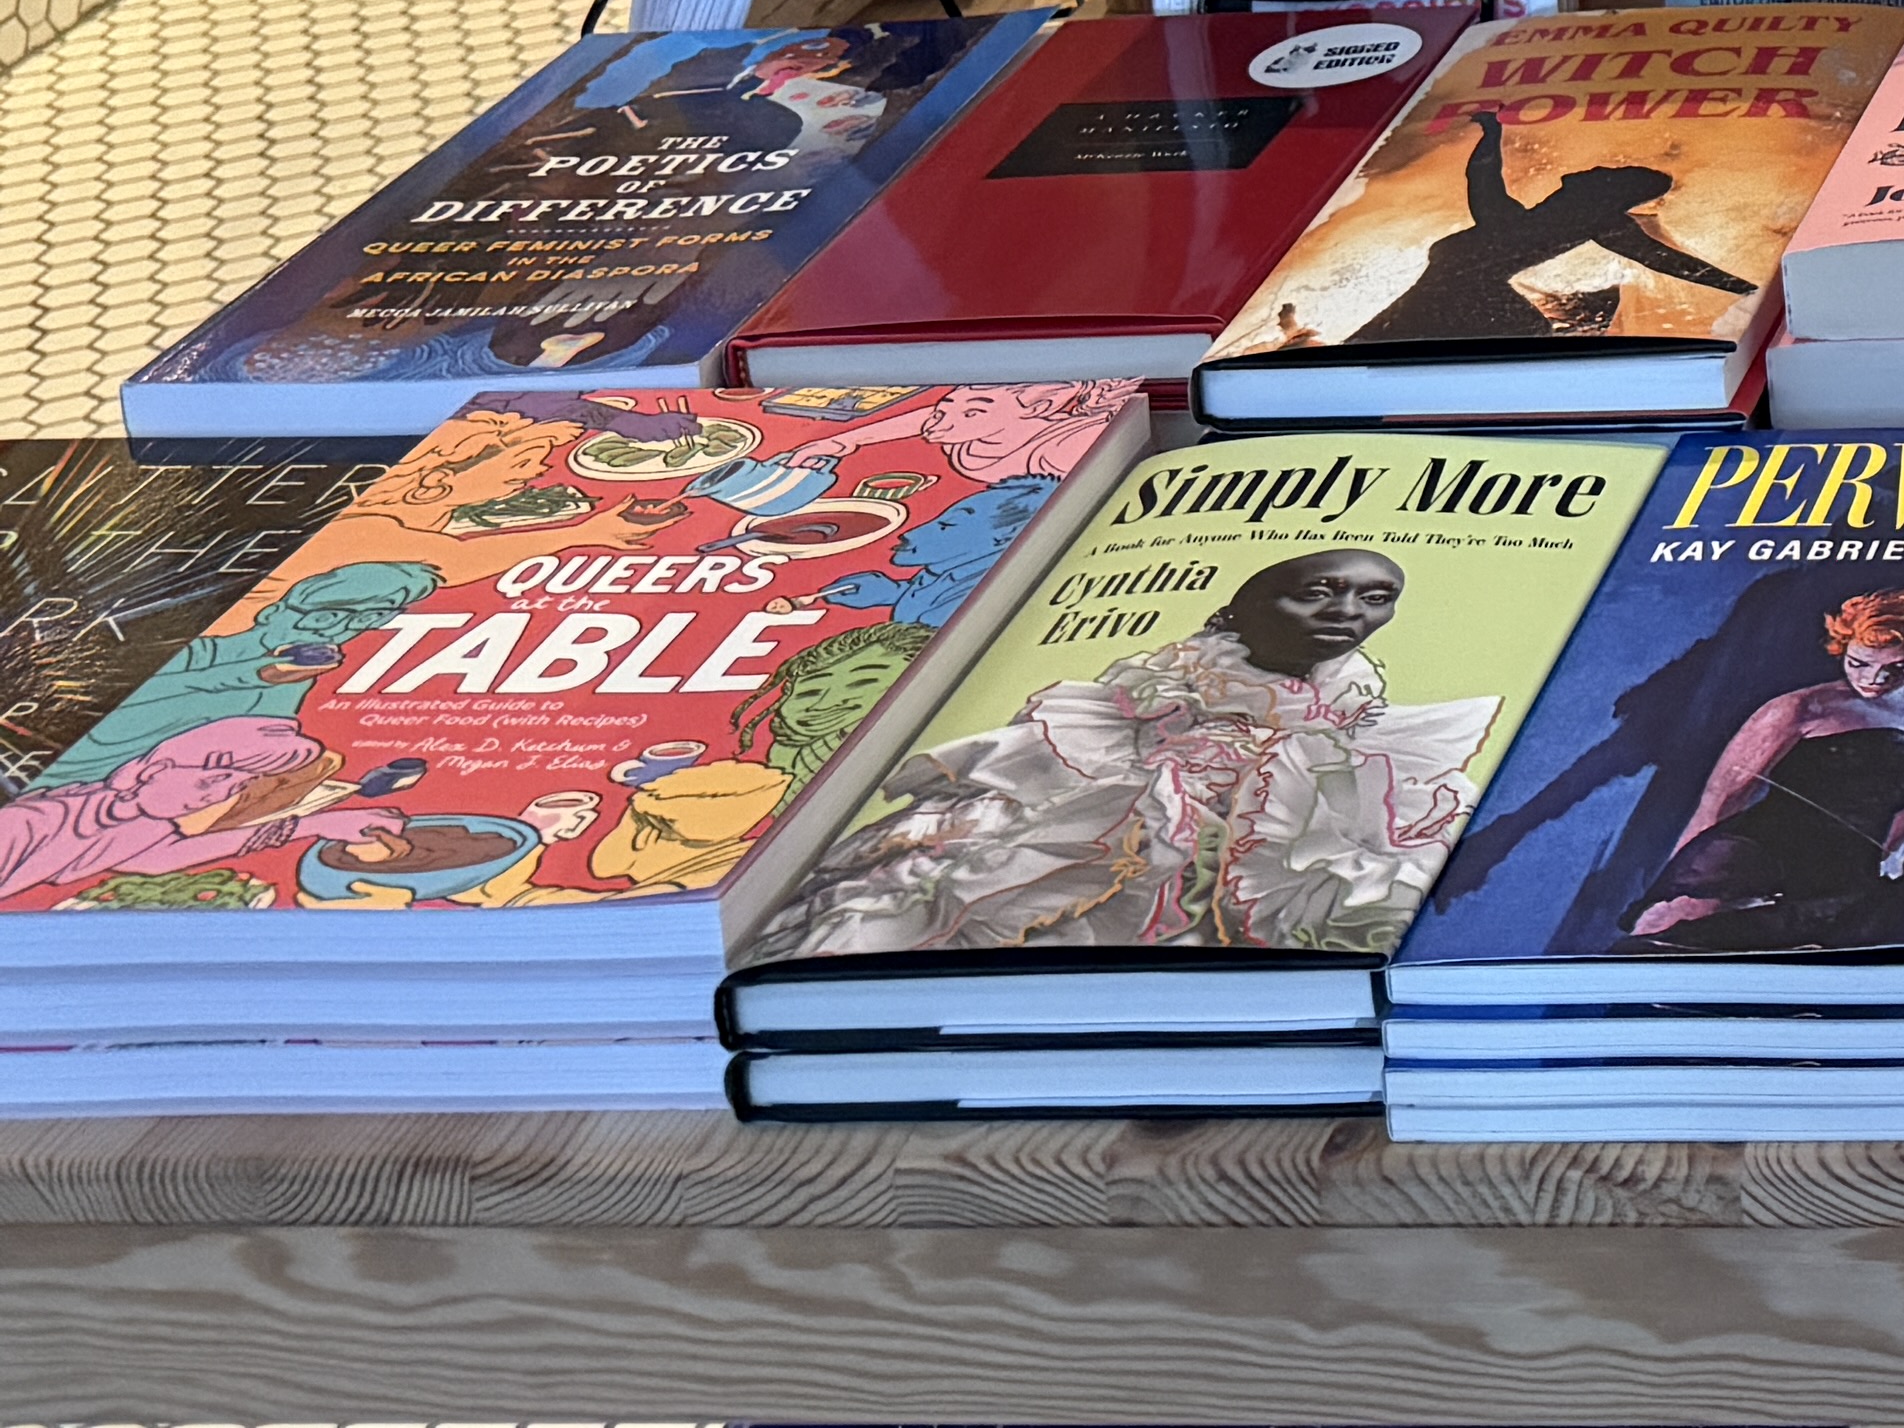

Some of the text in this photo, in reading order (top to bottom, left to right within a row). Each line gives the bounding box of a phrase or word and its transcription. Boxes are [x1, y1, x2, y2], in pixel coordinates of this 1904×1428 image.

[1491, 16, 1863, 48] EMMA QUILTY
[1476, 44, 1819, 89] WITCH
[1424, 85, 1814, 136] POWER
[657, 135, 729, 151] THE
[531, 148, 798, 178] POETICS
[616, 179, 665, 194] OF
[411, 188, 812, 226] DIFFERENCE
[1112, 455, 1607, 526] Simply More
[1085, 546, 1102, 558] A
[1103, 538, 1147, 554] Book
[1150, 533, 1175, 547] for
[1179, 532, 1242, 547] Anyone
[1249, 529, 1288, 542] Who
[1294, 530, 1326, 542] Has
[1331, 530, 1375, 542] Been
[1383, 530, 1418, 544] Told
[1492, 536, 1523, 548] Too
[1528, 536, 1574, 550] Much
[1649, 539, 1736, 562] KAY
[496, 553, 791, 596] QUEERS
[1048, 558, 1220, 609] Cynthia
[1039, 606, 1161, 647] Erivo
[333, 609, 831, 696] TABLE
